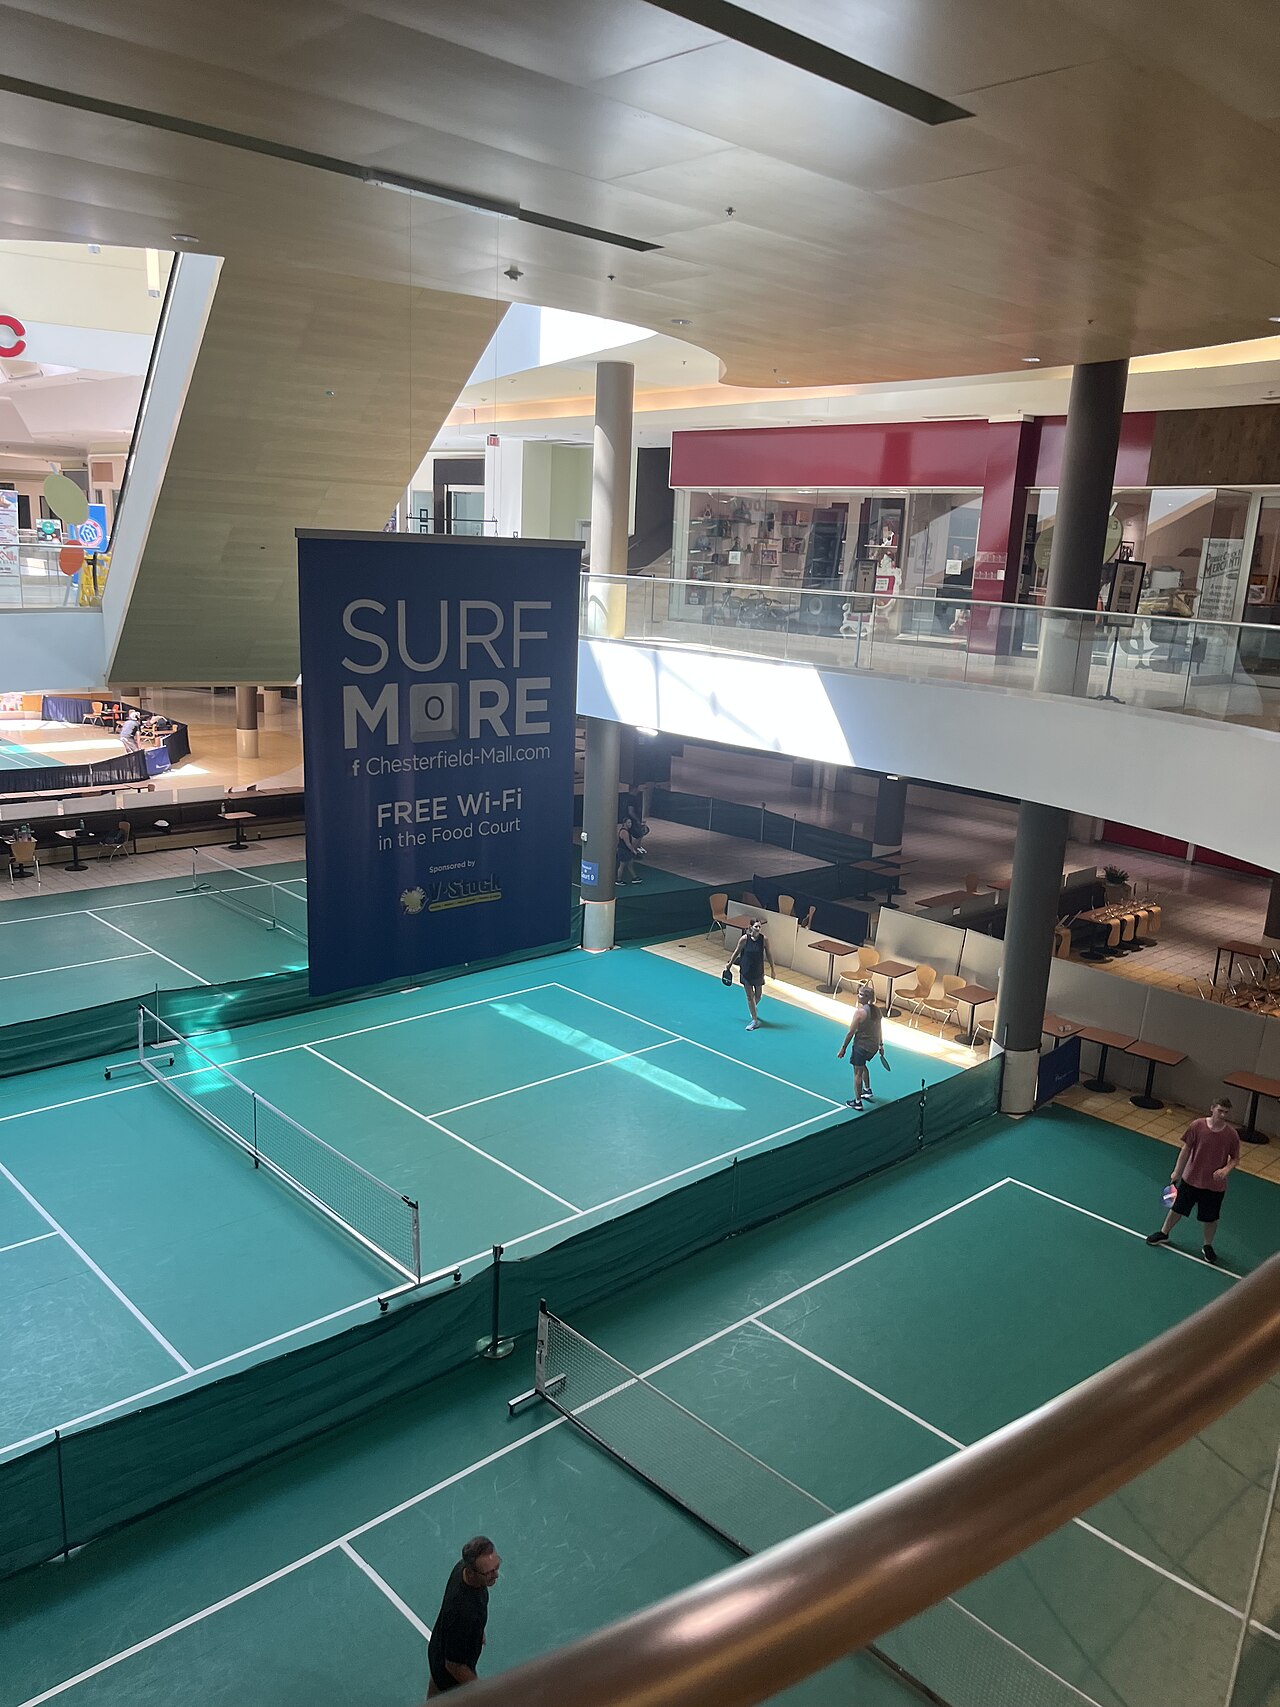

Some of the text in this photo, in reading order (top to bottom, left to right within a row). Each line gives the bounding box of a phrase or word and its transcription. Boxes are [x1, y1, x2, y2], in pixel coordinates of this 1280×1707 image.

[341, 598, 552, 675] SURF
[343, 676, 551, 749] MORE
[366, 745, 551, 776] Chesterfield-Mall.com
[377, 788, 523, 828] FREE Wi-Fi
[379, 817, 521, 851] in the Food Court
[429, 860, 476, 874] Sponsored by
